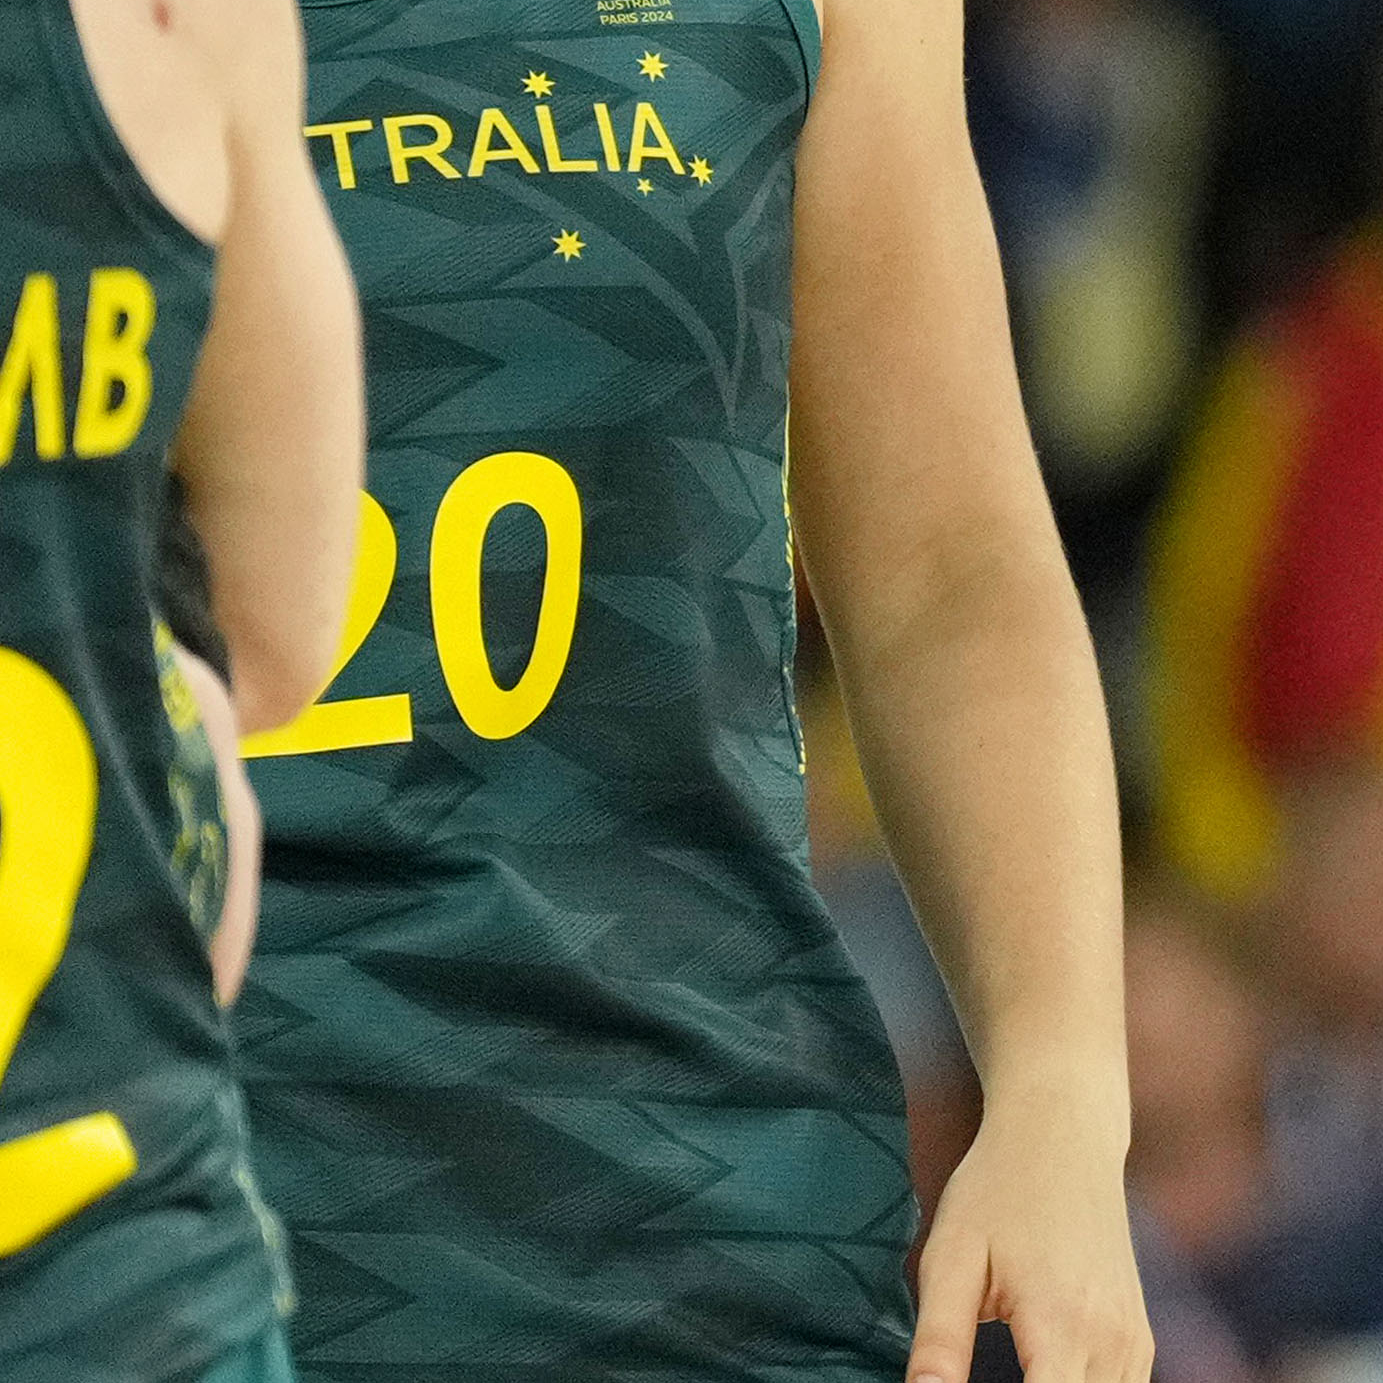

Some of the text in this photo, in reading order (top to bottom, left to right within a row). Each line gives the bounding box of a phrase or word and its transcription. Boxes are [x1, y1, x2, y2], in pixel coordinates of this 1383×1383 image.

[600, 10, 675, 25] PARIS 2024
[303, 101, 687, 190] TRALIA
[236, 450, 583, 760] 20
